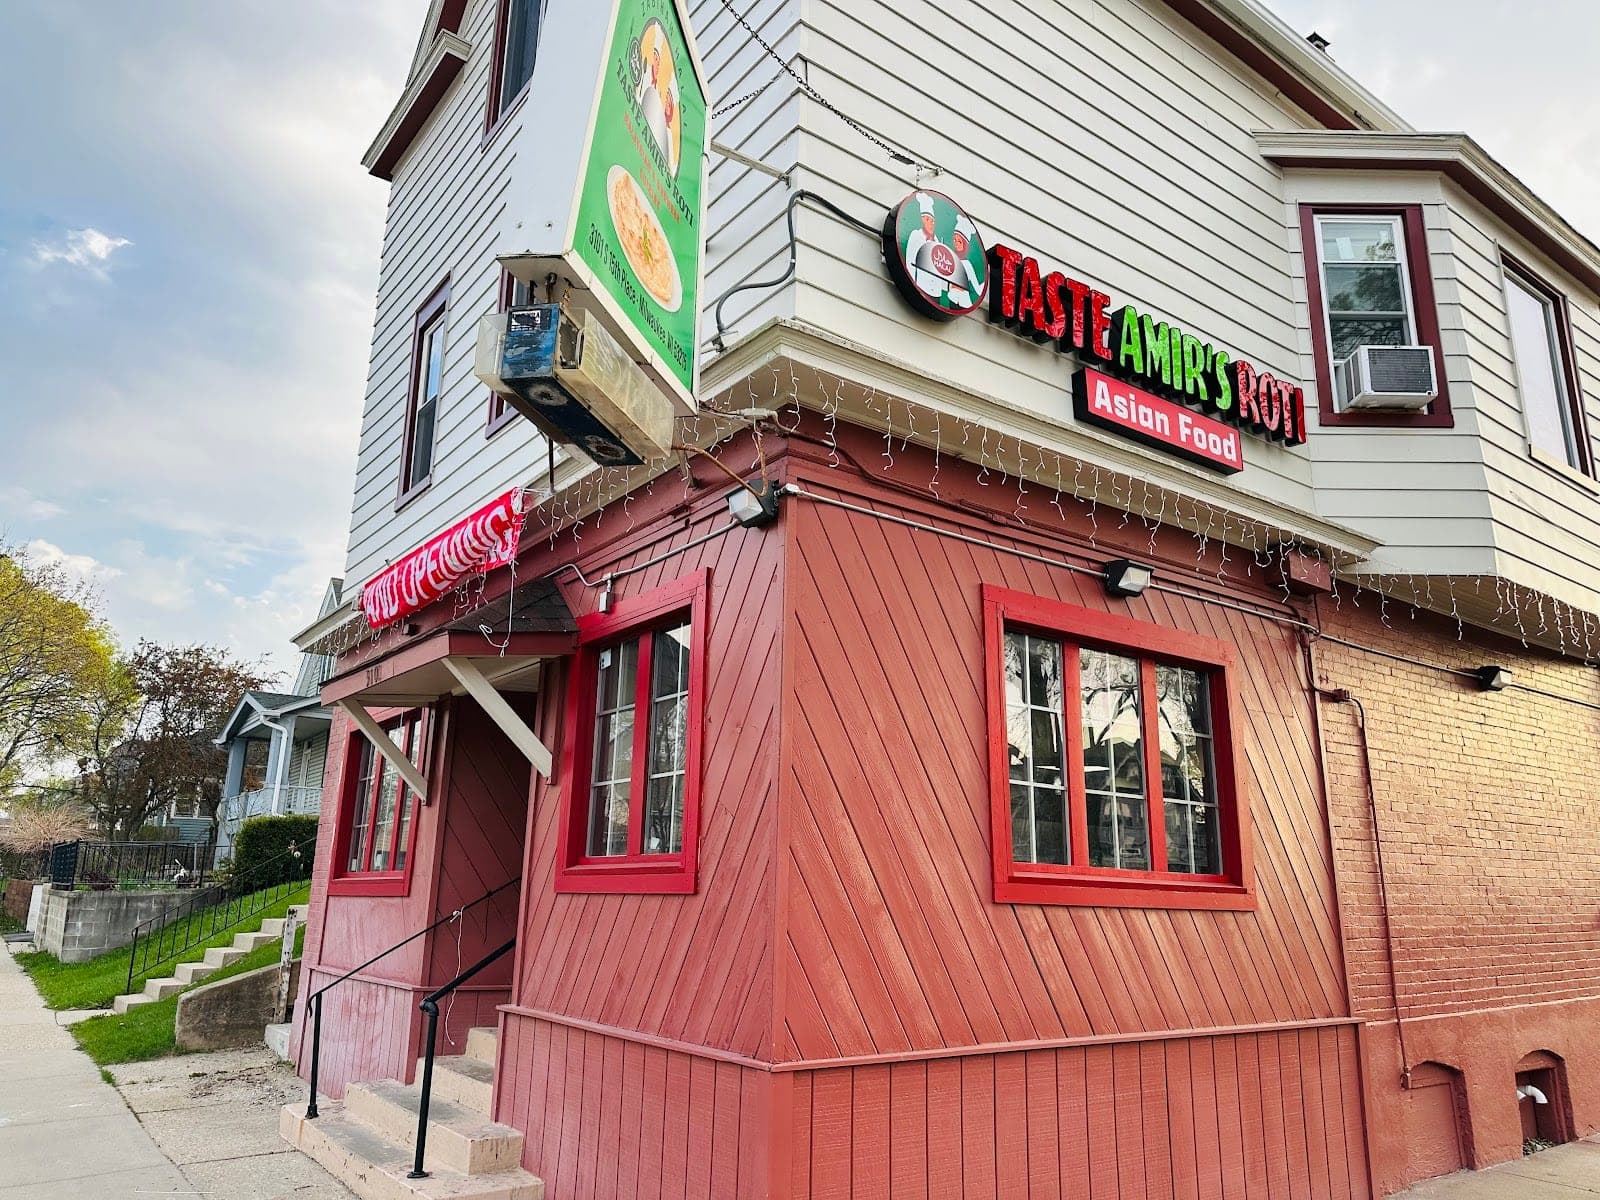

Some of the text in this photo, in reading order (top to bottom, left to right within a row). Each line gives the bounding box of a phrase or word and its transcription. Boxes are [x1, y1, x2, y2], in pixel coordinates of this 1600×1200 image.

[616, 58, 643, 126] TASTE
[642, 126, 672, 188] AMIR'S
[672, 185, 694, 227] ROTI
[589, 223, 604, 259] 3101
[604, 243, 609, 265] S
[621, 269, 636, 305] Place
[995, 243, 1307, 446] TASTE AMIR'S ROTI
[1093, 380, 1238, 463] Asian Food
